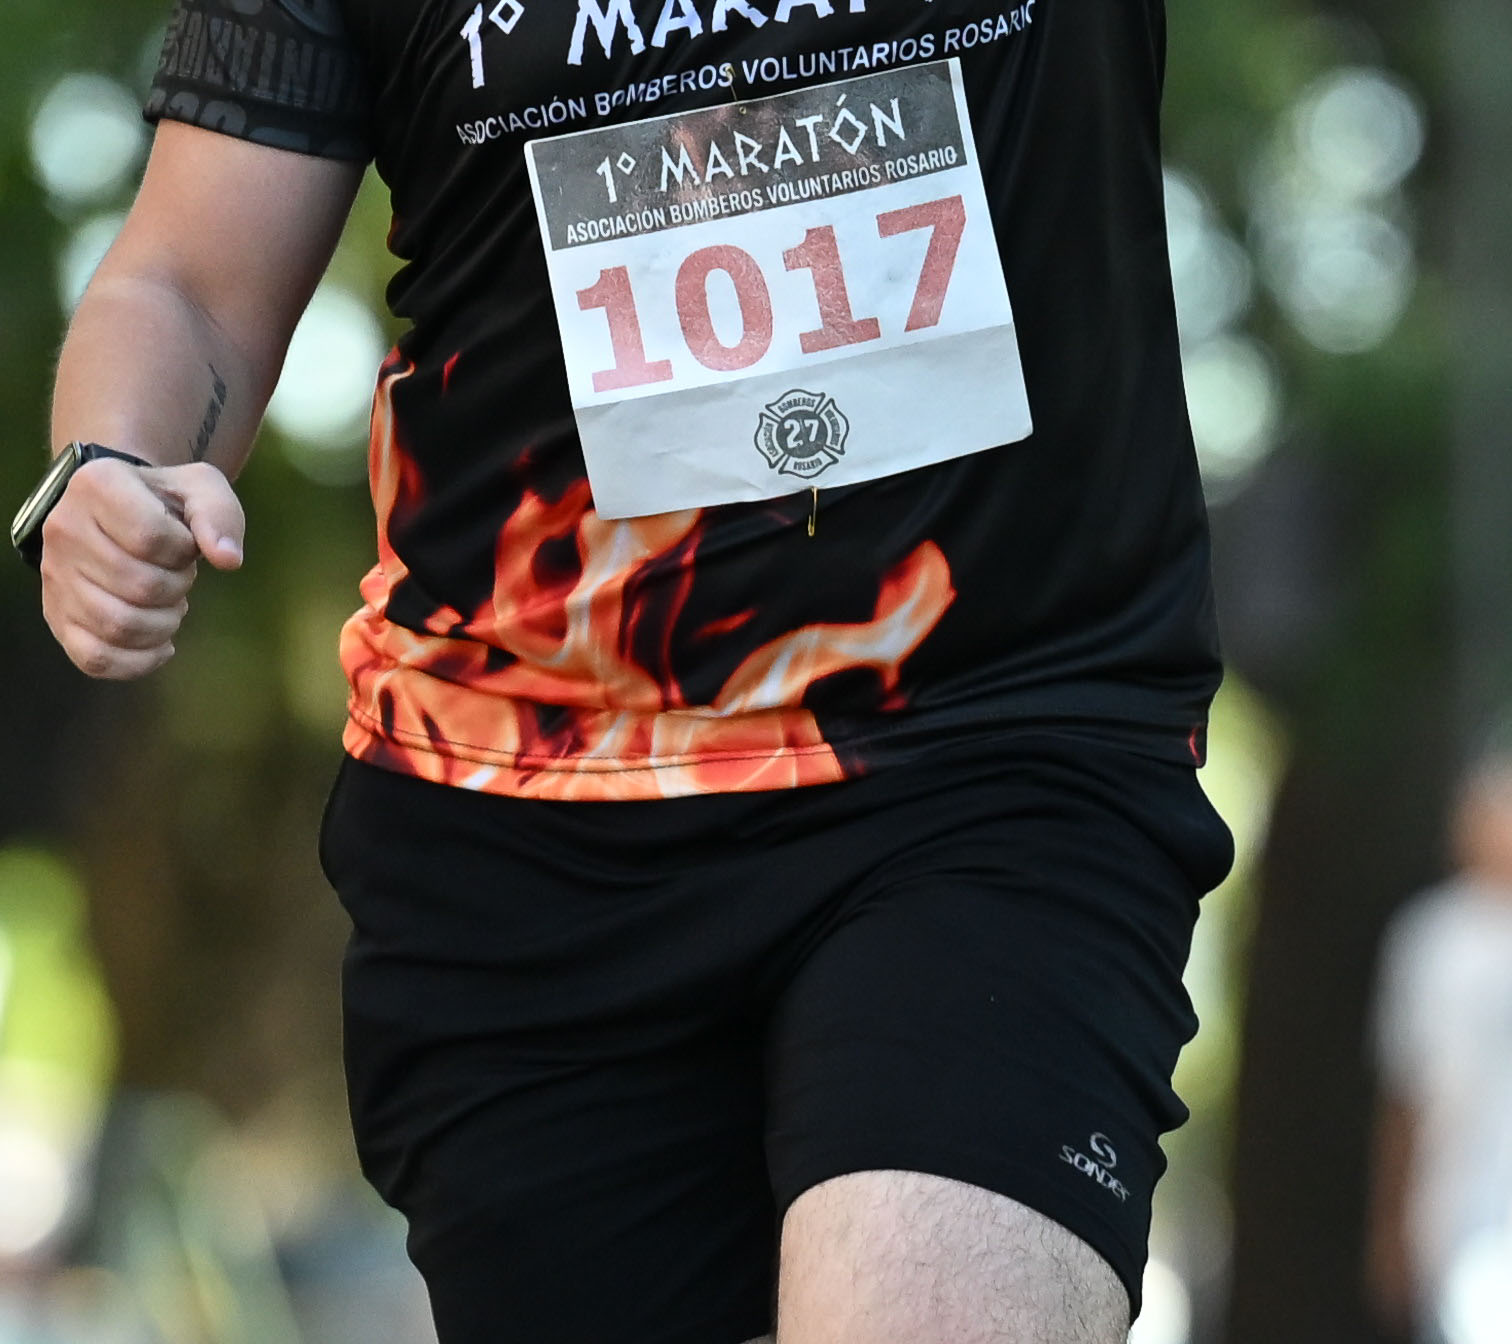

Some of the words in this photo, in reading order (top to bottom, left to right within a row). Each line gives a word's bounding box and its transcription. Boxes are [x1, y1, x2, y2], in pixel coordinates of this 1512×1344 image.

[456, 96, 587, 146] ASOCIACIÓN
[594, 62, 735, 116] BOMBEROS
[741, 32, 936, 85] VOLUNTARIOS
[656, 93, 906, 193] MARATÓN
[566, 203, 666, 245] ASOCIACIÓN
[669, 187, 763, 225] BOMBEROS
[766, 164, 881, 205] VOLUNTARIOS
[885, 144, 958, 180] ROSARIO
[575, 194, 967, 393] 1017
[783, 418, 820, 449] 27
